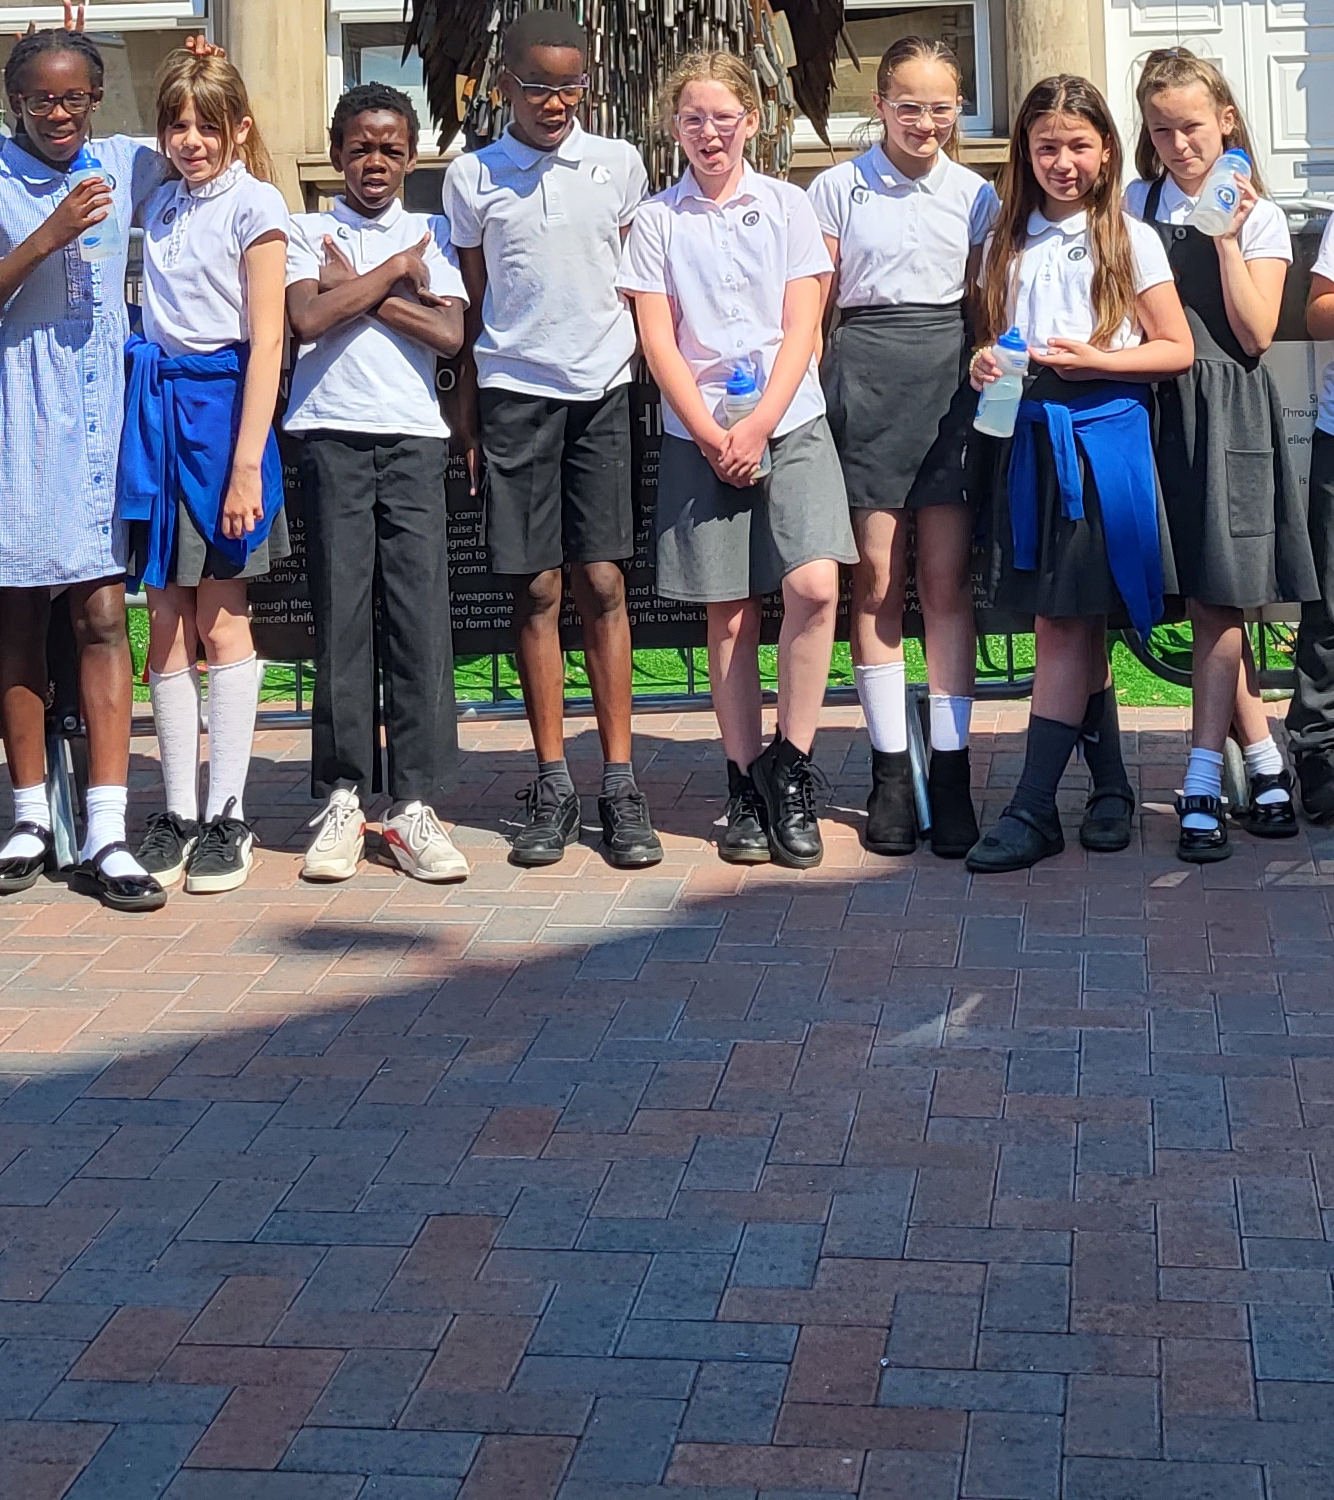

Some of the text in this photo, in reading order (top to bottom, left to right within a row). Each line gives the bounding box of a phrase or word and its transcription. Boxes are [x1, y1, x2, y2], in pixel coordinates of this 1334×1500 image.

[456, 591, 504, 605] weapons
[470, 605, 482, 616] to
[483, 605, 514, 616] come
[465, 618, 491, 630] form
[492, 617, 512, 629] the
[657, 612, 669, 623] to
